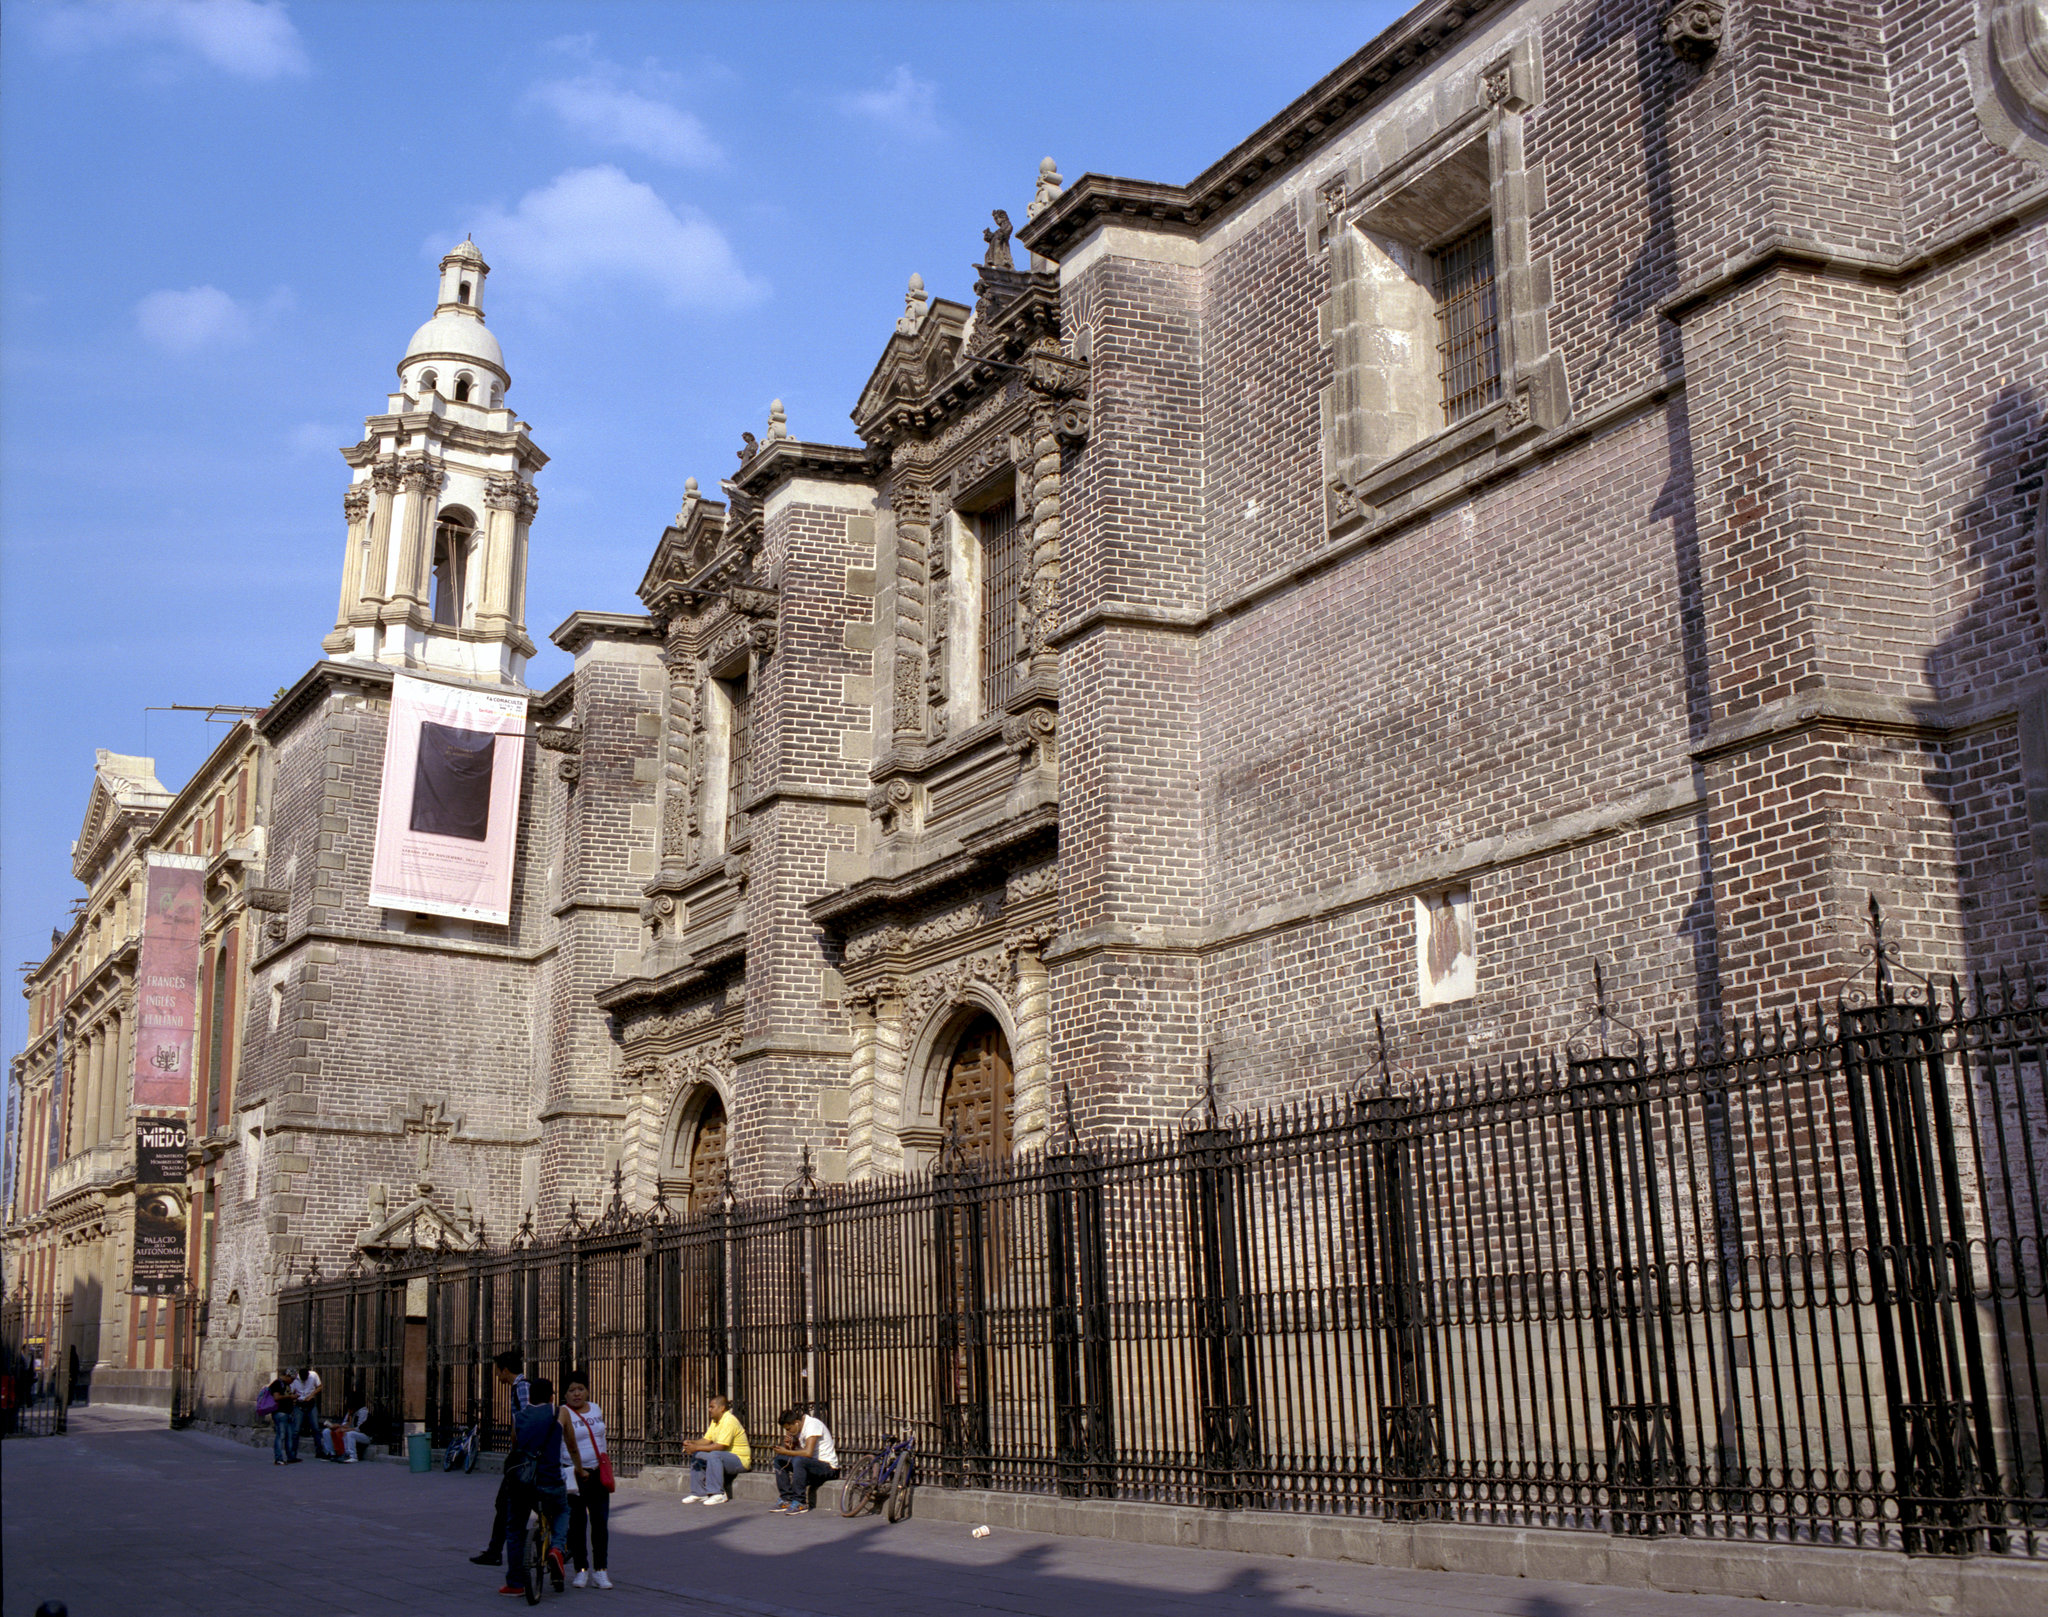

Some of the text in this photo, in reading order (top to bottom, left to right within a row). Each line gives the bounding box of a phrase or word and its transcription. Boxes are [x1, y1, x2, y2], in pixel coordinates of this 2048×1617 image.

[147, 975, 186, 989] FRANCÉS
[146, 994, 176, 1008] INGLÉS
[144, 1013, 184, 1027] ITALIANO
[137, 1126, 187, 1148] EL MIEDO
[143, 1236, 177, 1244] PALACIO
[135, 1247, 185, 1256] AUTONOMÍA
